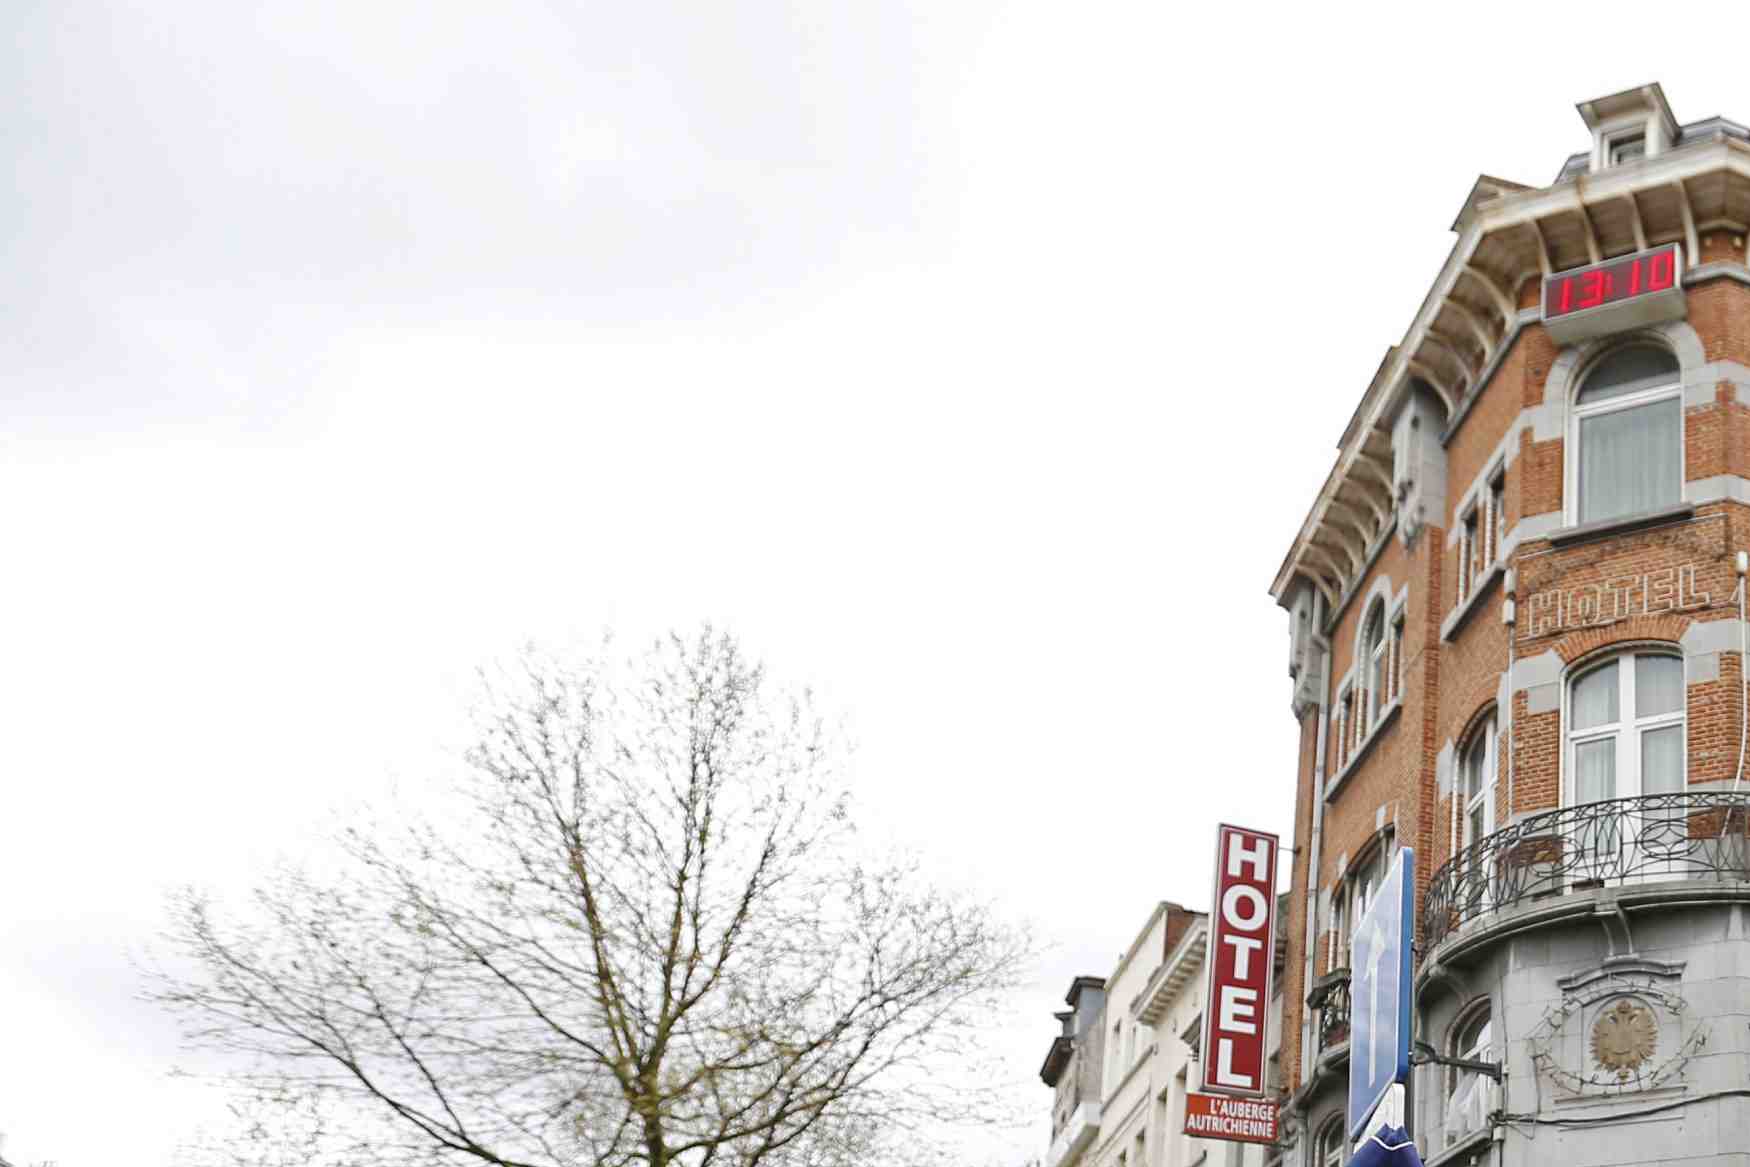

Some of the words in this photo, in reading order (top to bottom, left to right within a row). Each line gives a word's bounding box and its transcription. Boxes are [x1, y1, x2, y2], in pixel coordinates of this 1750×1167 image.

[1529, 564, 1712, 637] HOTEL
[1216, 832, 1269, 1087] HOTEL
[1187, 1113, 1274, 1137] AUTRICHIENNE
[1210, 1098, 1274, 1121] L'AUBERGE
